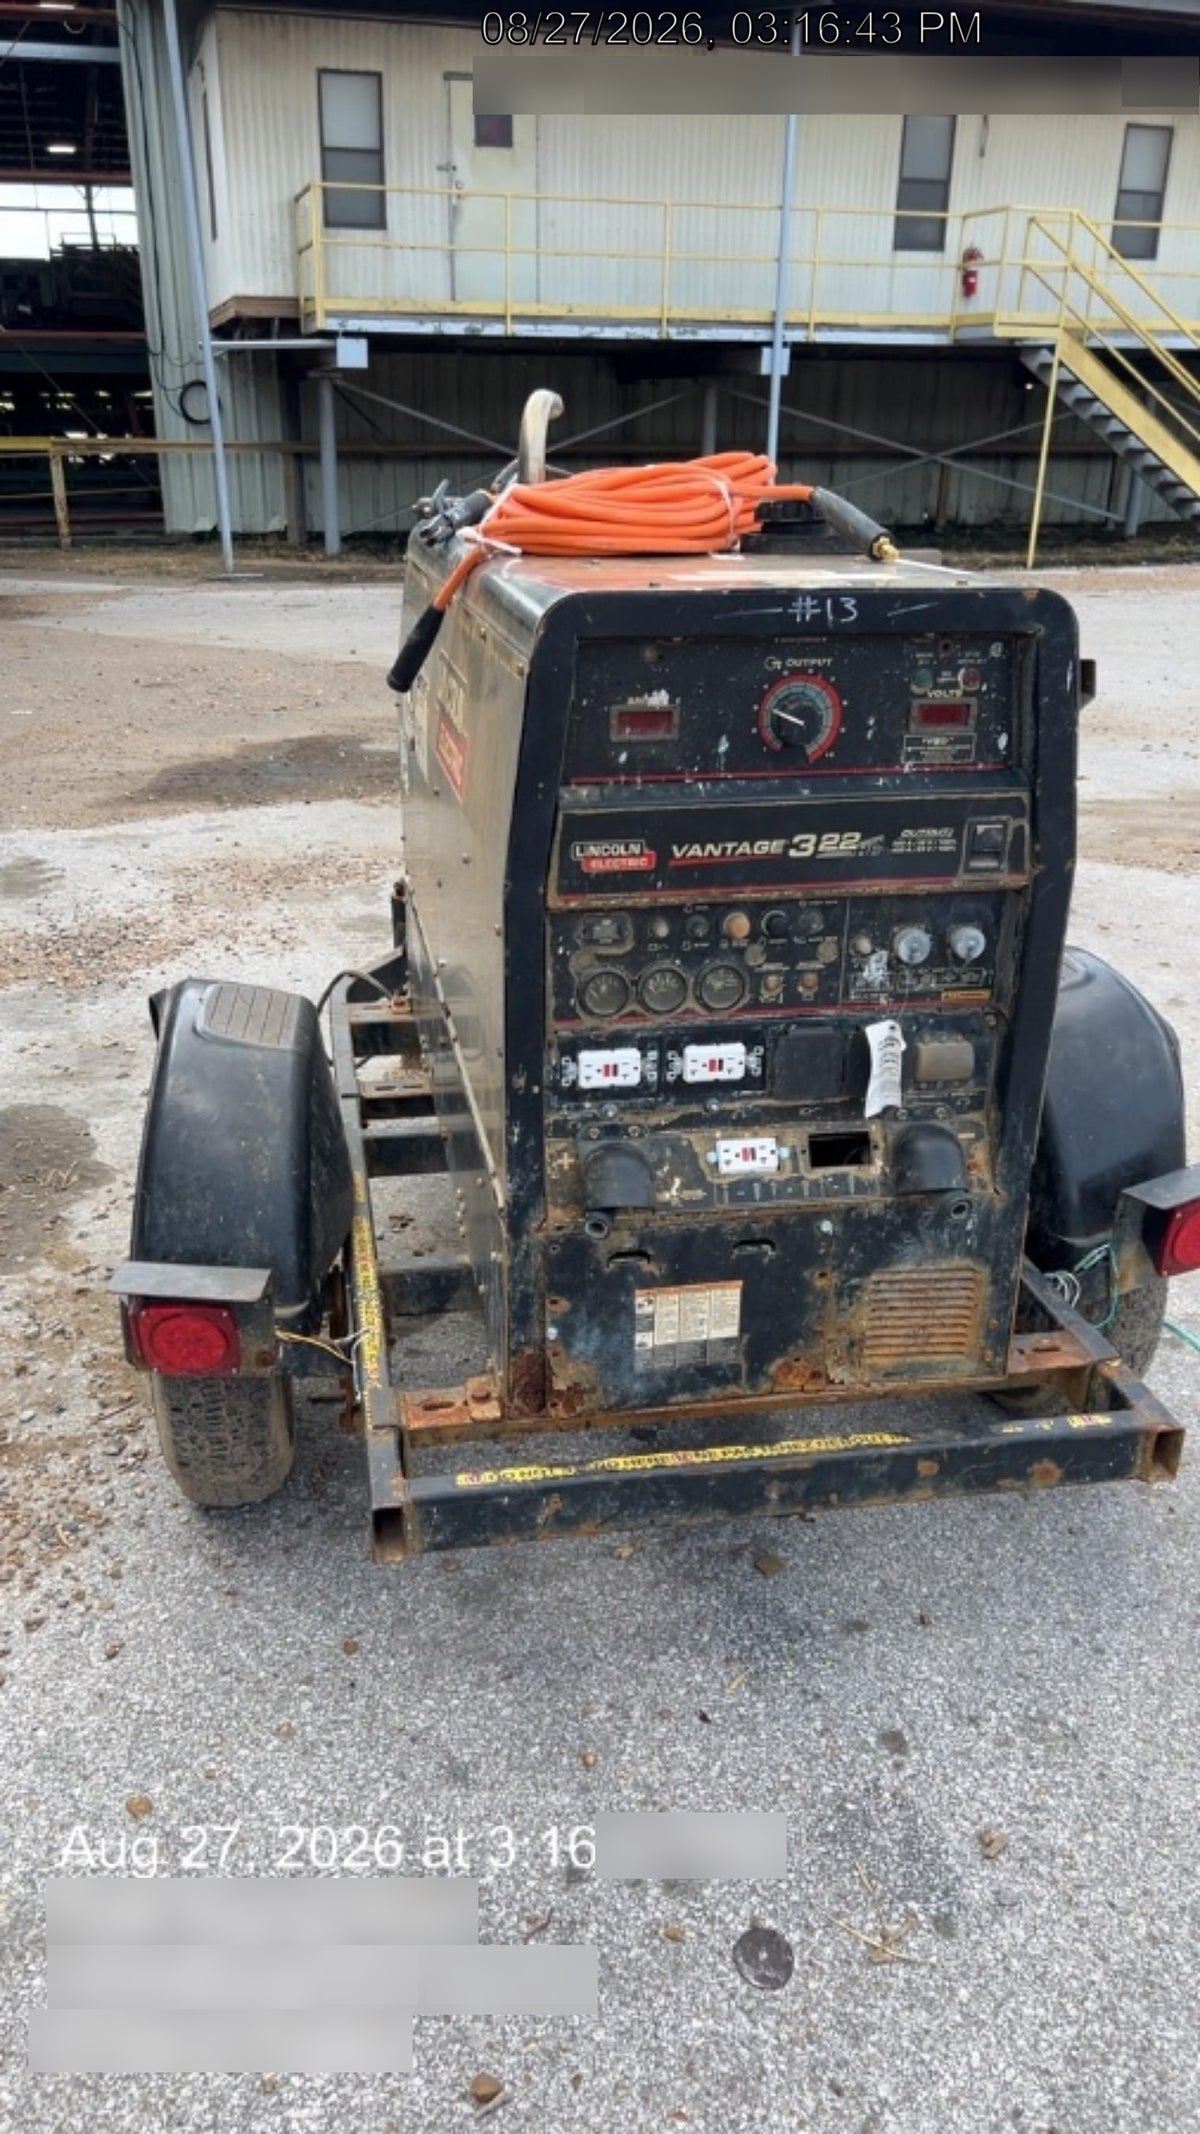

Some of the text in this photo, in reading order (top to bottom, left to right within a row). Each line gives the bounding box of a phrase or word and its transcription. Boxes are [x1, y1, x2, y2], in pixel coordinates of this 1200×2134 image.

[787, 596, 859, 629] #13
[785, 658, 834, 668] OUTPUT
[575, 843, 642, 858] LINCOLN
[671, 838, 787, 859] VANTAGE
[788, 831, 862, 859] 322
[589, 857, 648, 869] ELECTRIC
